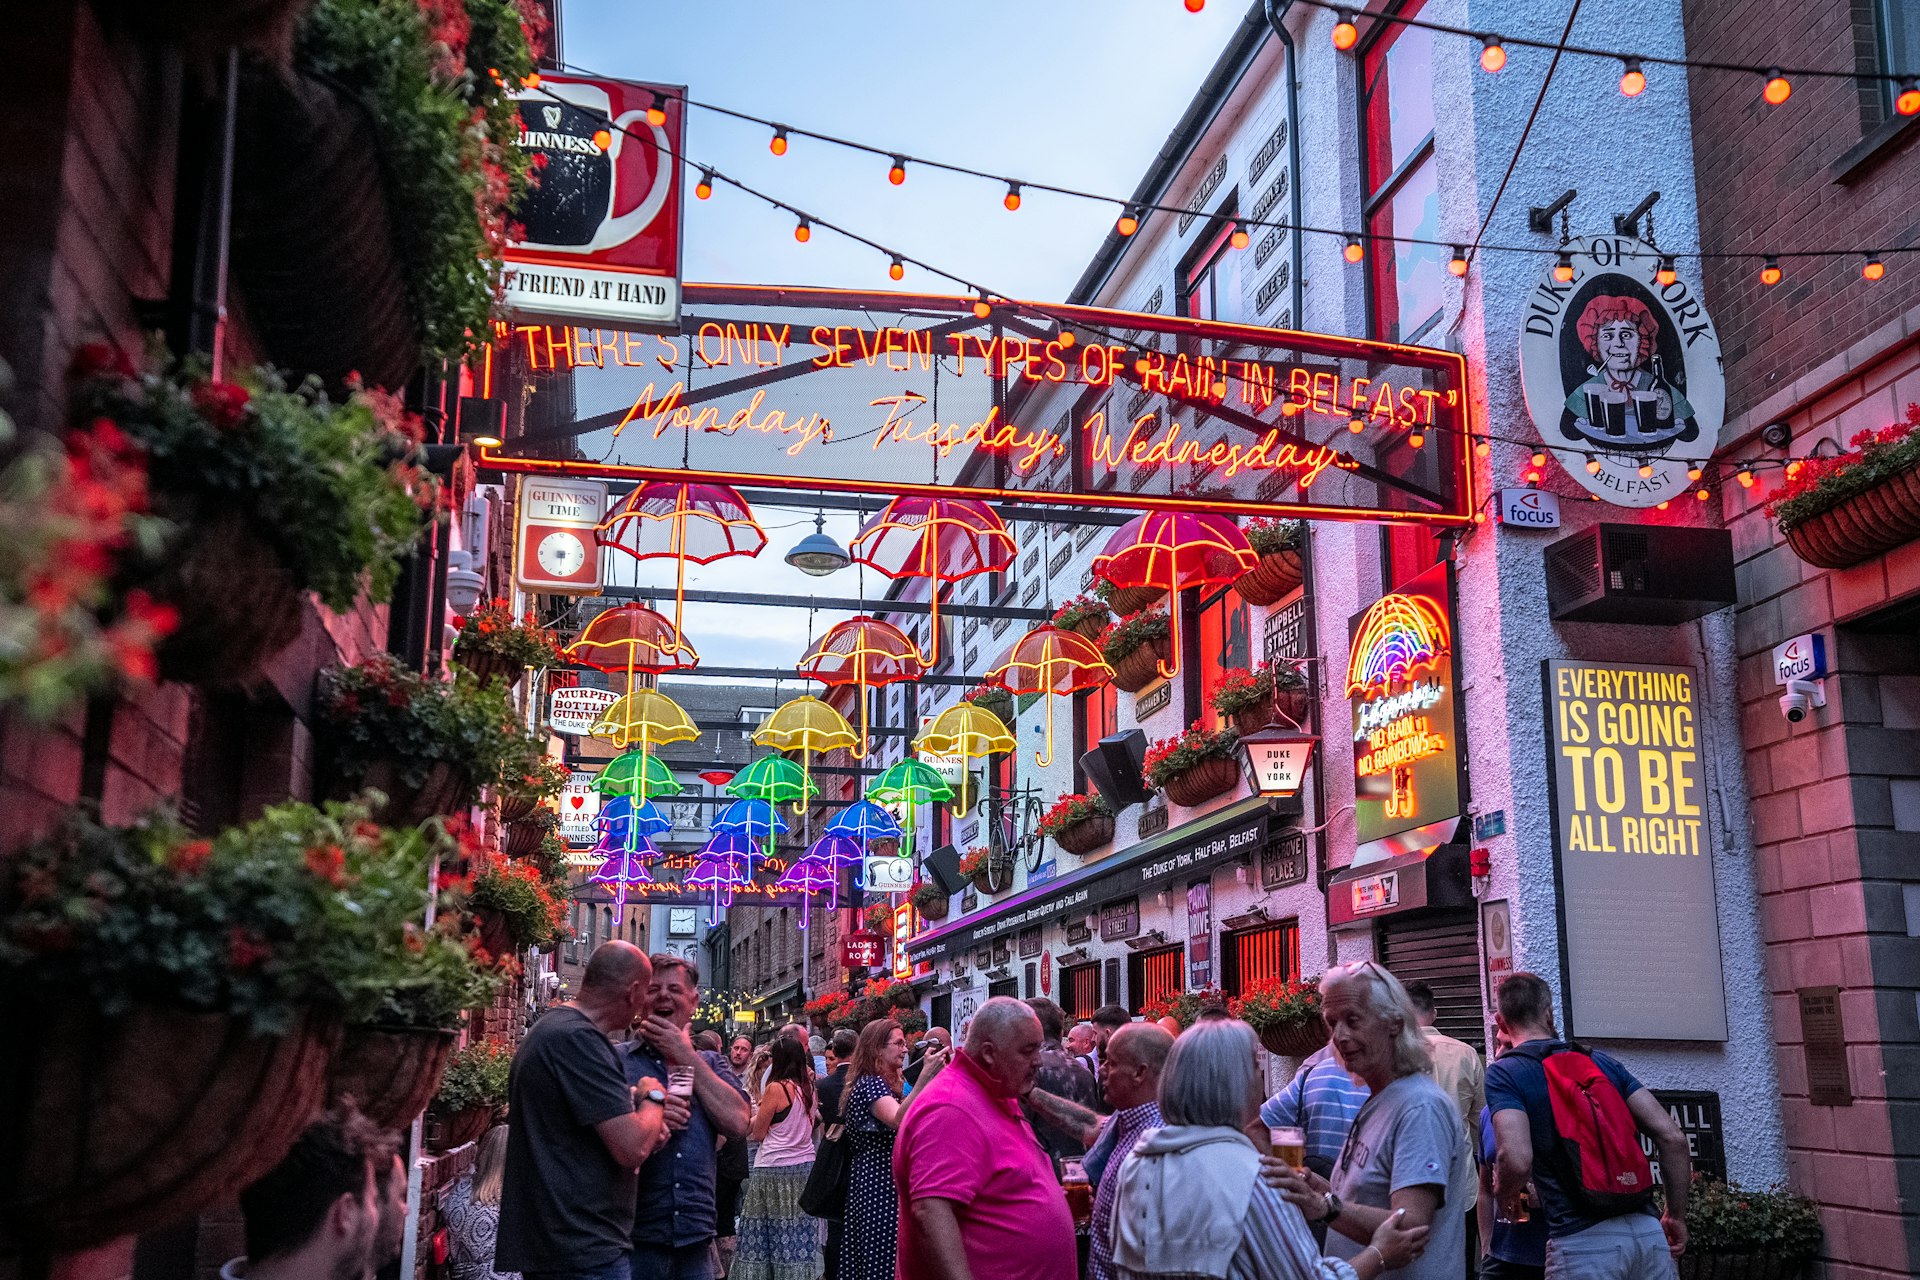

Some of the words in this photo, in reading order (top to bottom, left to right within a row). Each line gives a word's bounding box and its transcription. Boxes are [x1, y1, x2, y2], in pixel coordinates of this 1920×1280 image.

[509, 131, 603, 156] UINNESS
[1591, 238, 1633, 267] OF
[518, 272, 585, 297] FRIEND
[589, 280, 613, 300] AT
[617, 283, 666, 306] HAND
[698, 322, 789, 367] ONLY
[812, 325, 932, 372] SEVEN
[949, 333, 1067, 383] TYPES
[1082, 343, 1127, 386] OF
[1143, 351, 1228, 400] RAIN
[1242, 361, 1274, 406] IN
[1594, 468, 1672, 496] BELFAST
[531, 489, 597, 506] GUINNESS
[548, 503, 582, 518] TIME
[1510, 504, 1555, 524] focus
[1264, 601, 1304, 639] CAMPBELL
[1267, 622, 1300, 654] STREET
[1779, 656, 1810, 681] focus
[1557, 667, 1691, 703] EVERYTHING
[555, 719, 567, 727] THE
[568, 720, 586, 729] DUKE
[1370, 728, 1385, 751] NO
[1388, 715, 1415, 741] RAIN
[1559, 700, 1590, 744] IS
[1597, 702, 1695, 748] GOING
[924, 756, 963, 764] GUINNES
[1267, 750, 1290, 759] DUKE
[1358, 754, 1373, 776] NO
[1374, 732, 1429, 770] RAINBOWS
[1267, 773, 1291, 781] YORK
[1562, 746, 1626, 813] TO
[1638, 749, 1701, 816] BE
[1569, 815, 1617, 853] ALL
[1622, 816, 1701, 856] RIGHT
[1142, 867, 1153, 880] THE
[1153, 861, 1168, 876] DUKE
[1168, 859, 1176, 871] OF
[1176, 852, 1193, 869] YORK,
[1195, 845, 1212, 861] HALF
[1212, 840, 1227, 855] BAP,
[1229, 827, 1259, 849] BELFAST
[1269, 862, 1295, 884] PLACE
[1489, 956, 1511, 971] GUINNESS
